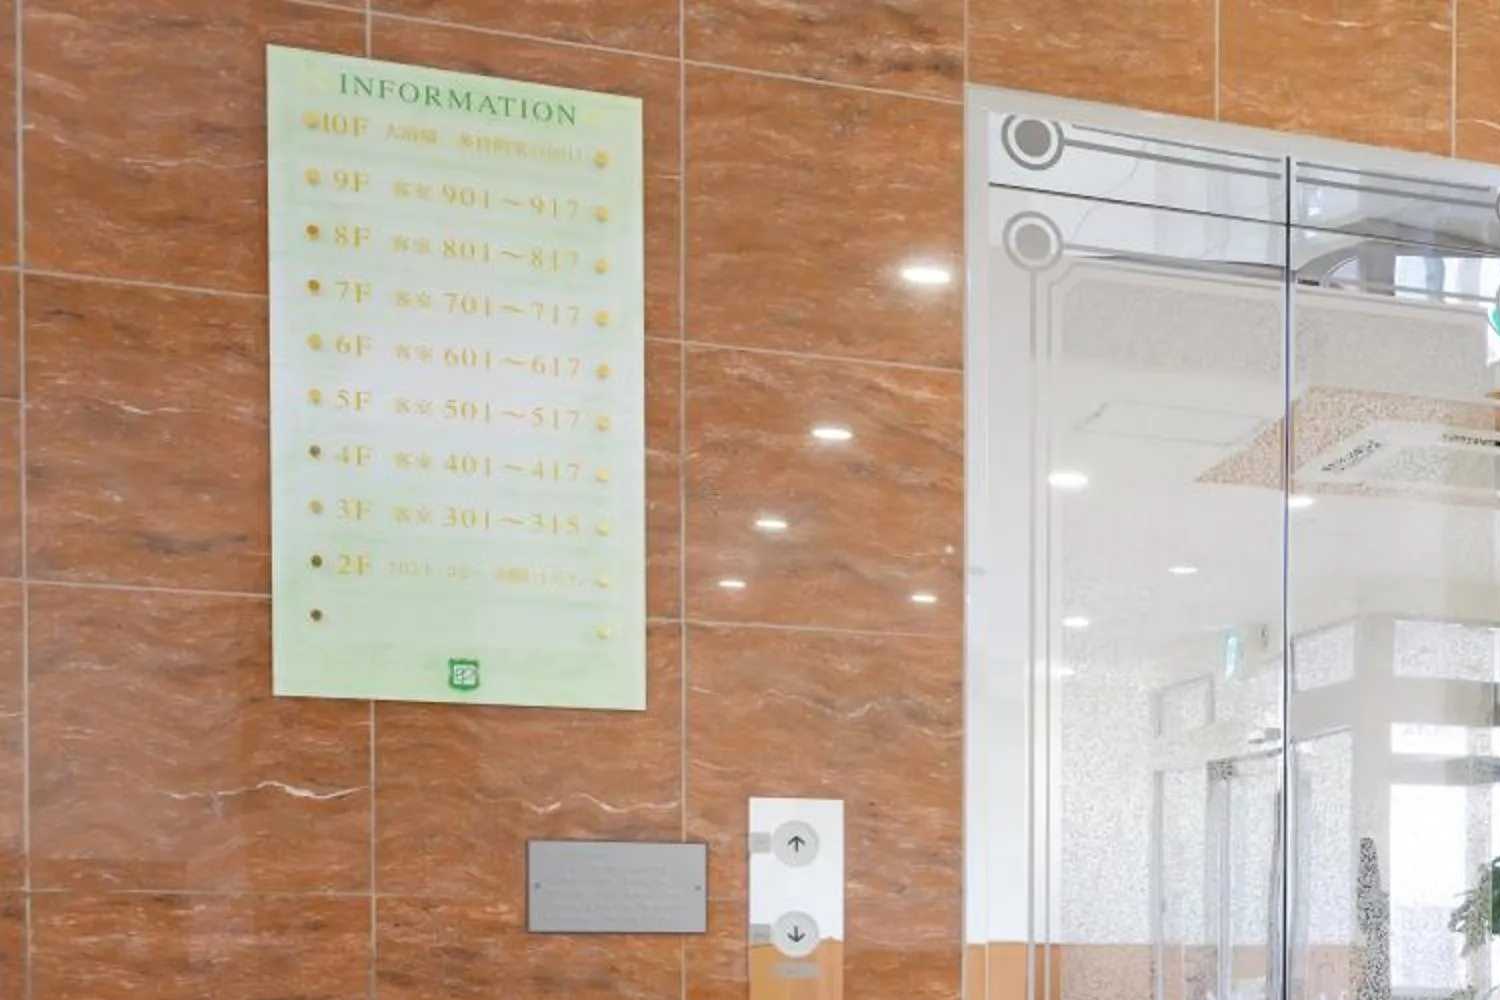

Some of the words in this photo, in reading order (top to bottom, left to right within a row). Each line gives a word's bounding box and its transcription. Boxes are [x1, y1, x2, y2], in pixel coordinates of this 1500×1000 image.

[339, 71, 578, 127] INFORMATION
[323, 112, 368, 138] 10F
[333, 169, 370, 193] 9F
[334, 225, 371, 249] 8F
[335, 281, 372, 304] 7F
[335, 334, 373, 358] 6F
[336, 388, 372, 412] 5F
[335, 445, 373, 467] 4F
[336, 498, 373, 521] 3F
[336, 554, 372, 577] 2F
